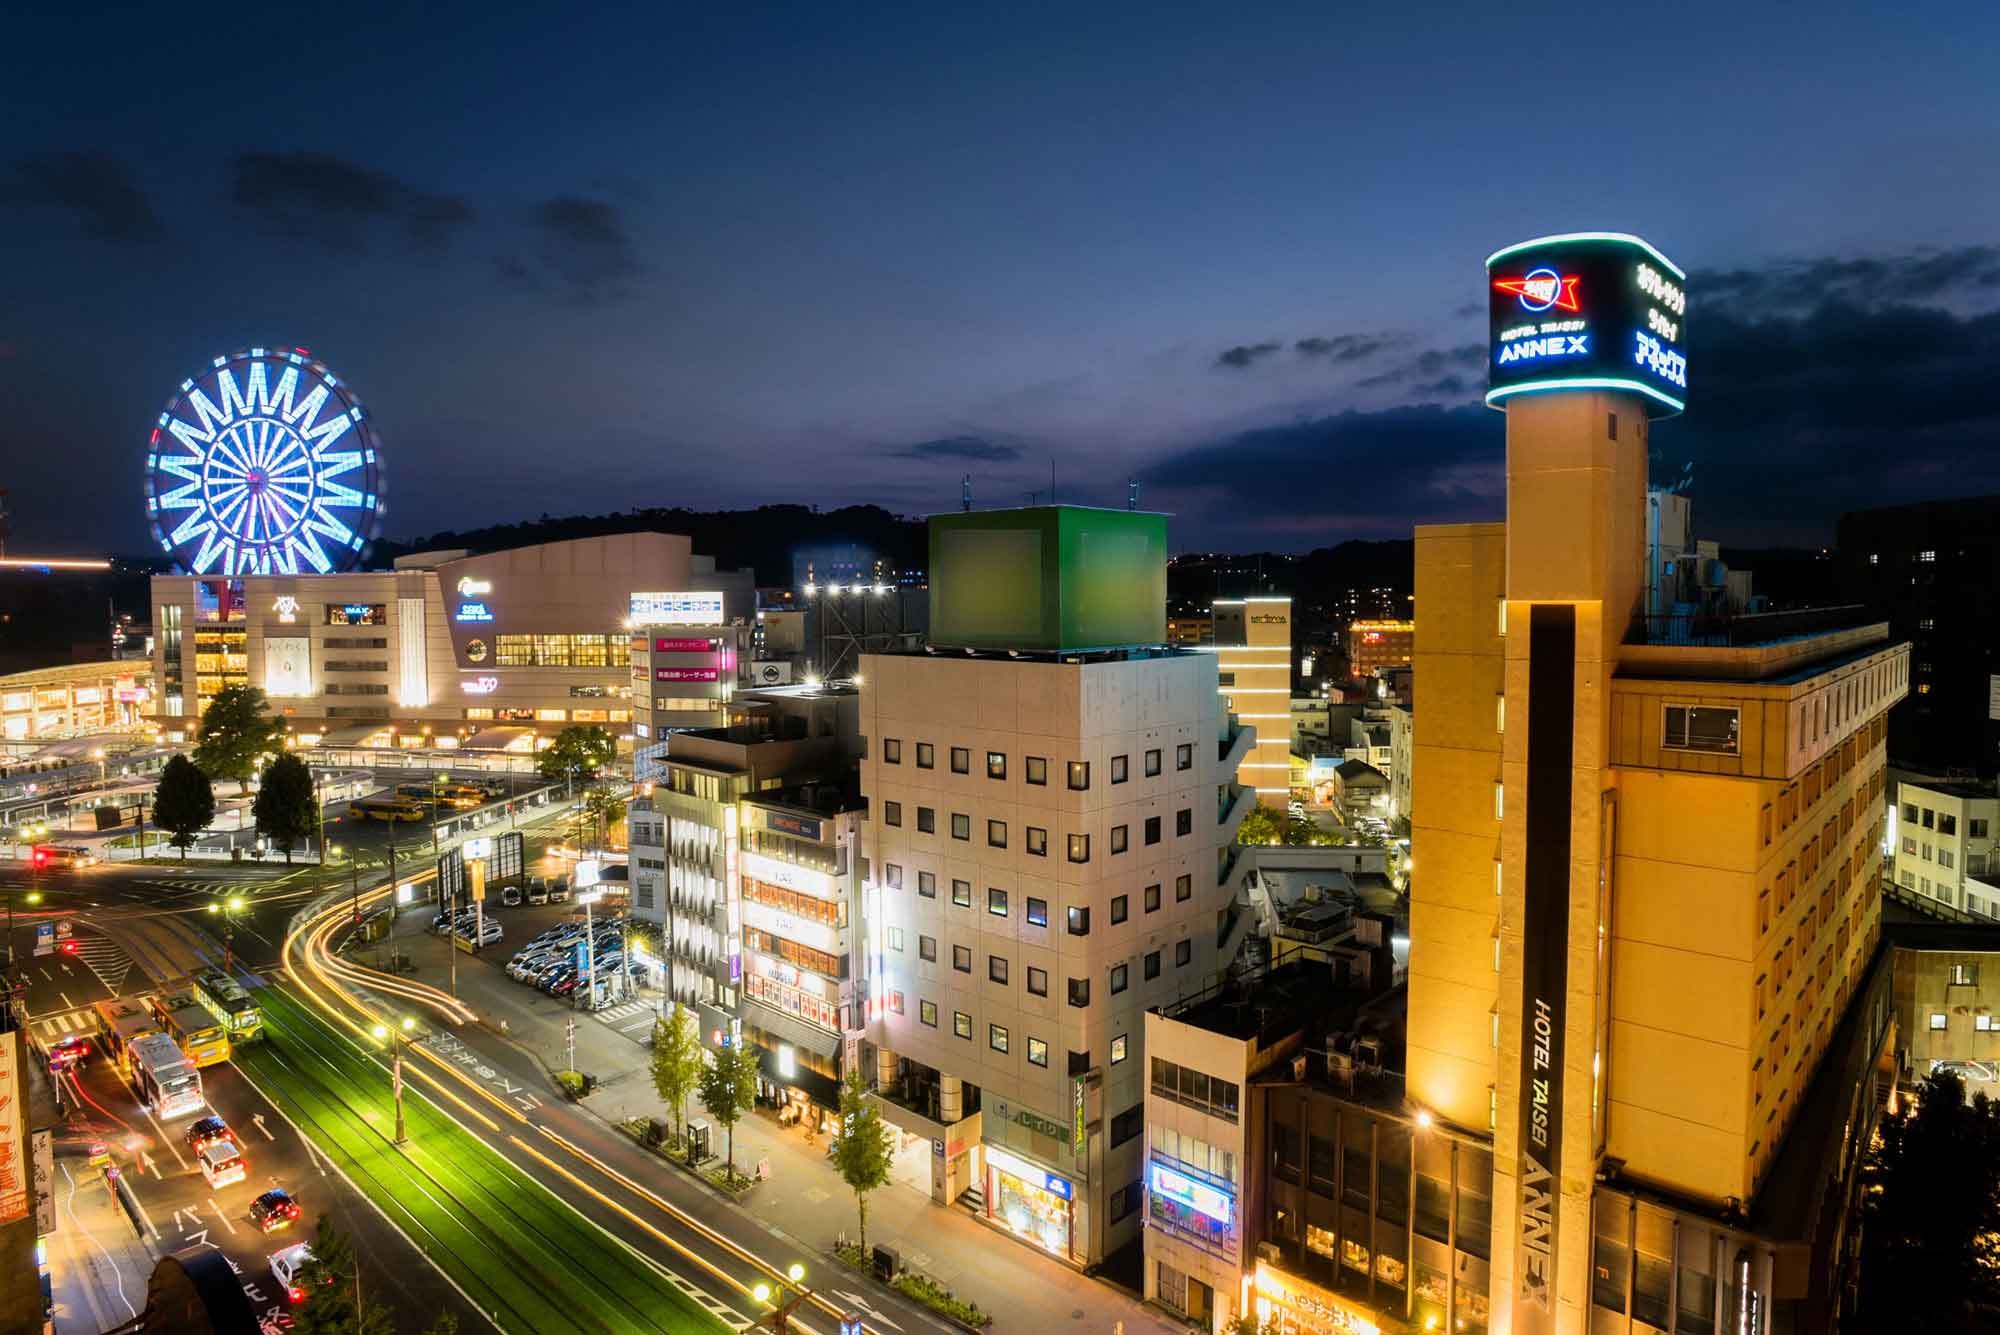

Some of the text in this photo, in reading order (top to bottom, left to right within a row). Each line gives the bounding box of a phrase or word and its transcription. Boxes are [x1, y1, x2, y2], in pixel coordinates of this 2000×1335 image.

[1498, 335, 1589, 364] ANNEX
[345, 606, 369, 615] IMAX
[1532, 998, 1551, 1148] HOTEL TAISEI
[933, 1139, 944, 1153] P
[1520, 1150, 1553, 1314] ANNEX
